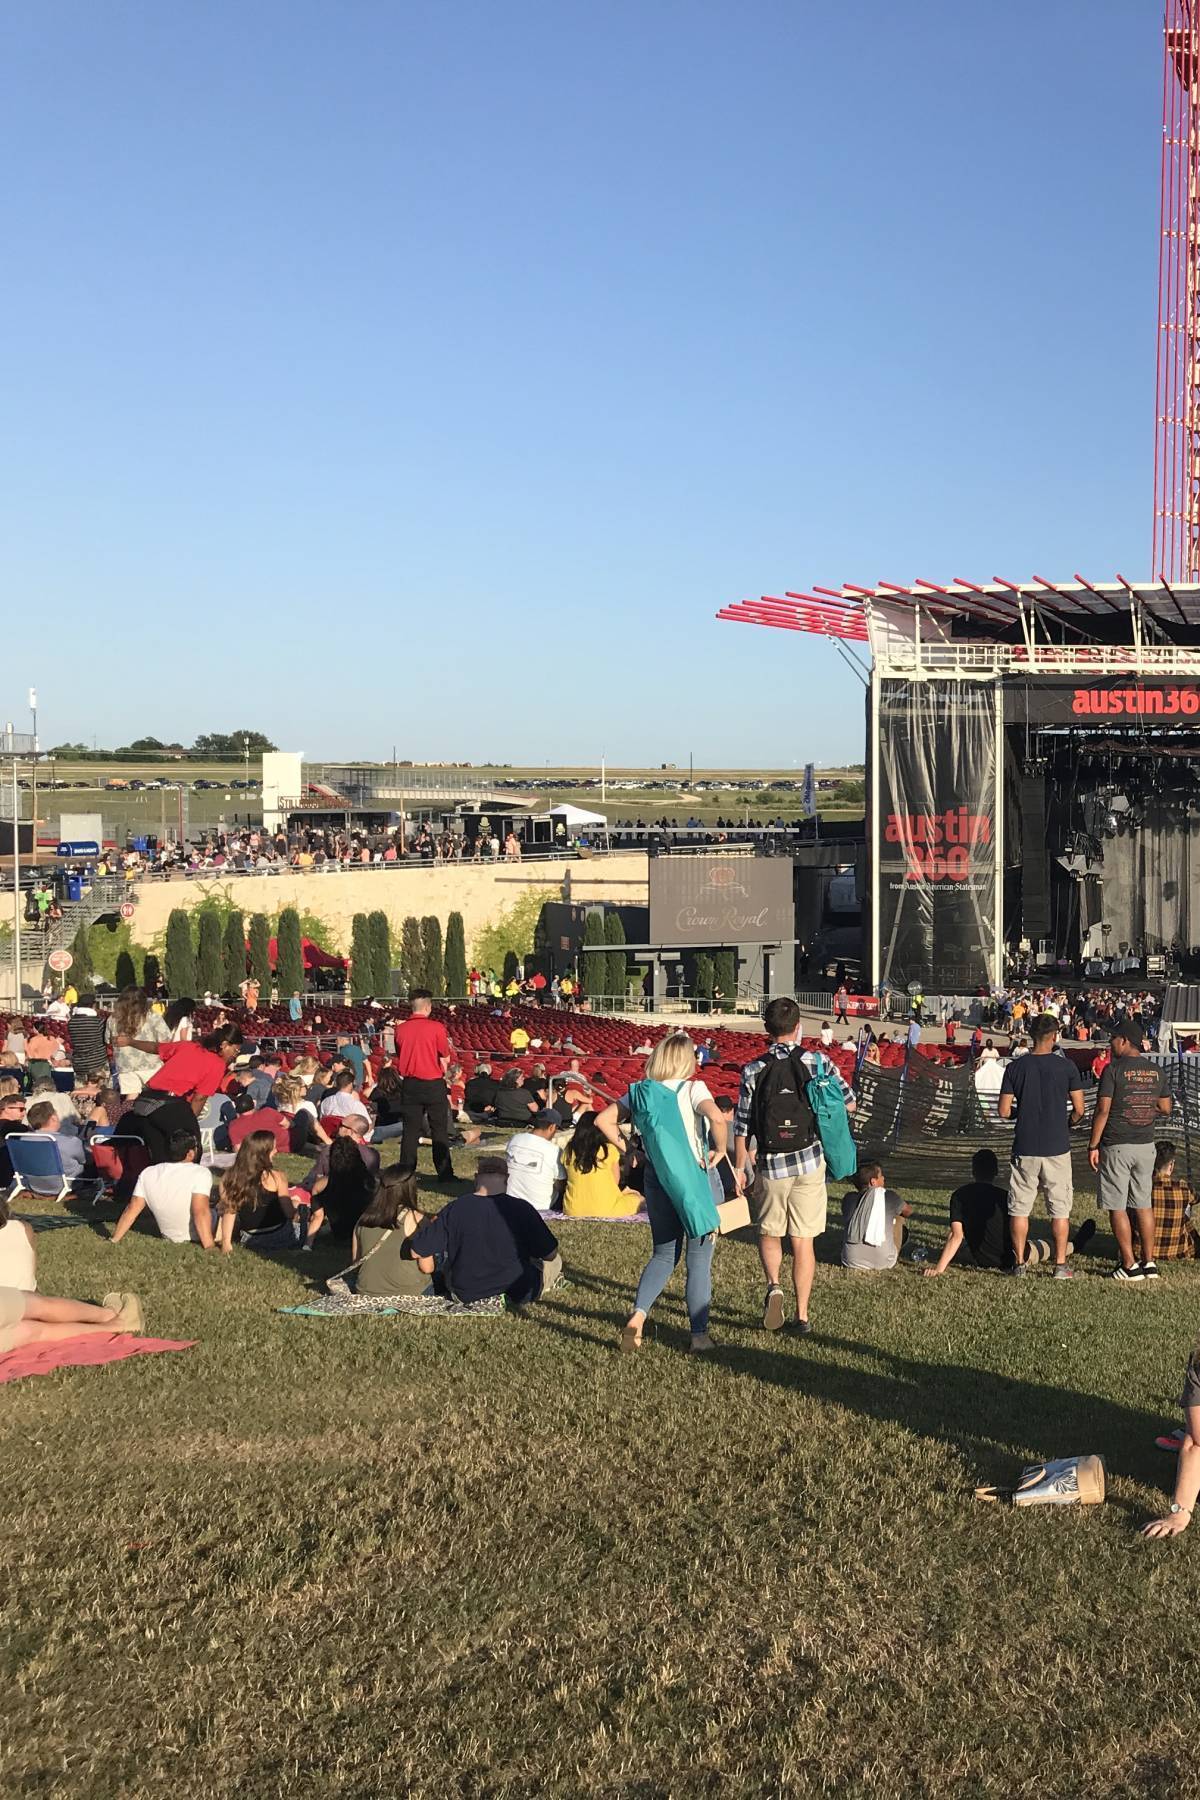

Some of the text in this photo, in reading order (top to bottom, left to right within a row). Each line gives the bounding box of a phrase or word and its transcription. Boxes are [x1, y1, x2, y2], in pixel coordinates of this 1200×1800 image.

[885, 806, 990, 843] austin
[906, 846, 969, 881] 360
[676, 906, 769, 931] Crown Royal
